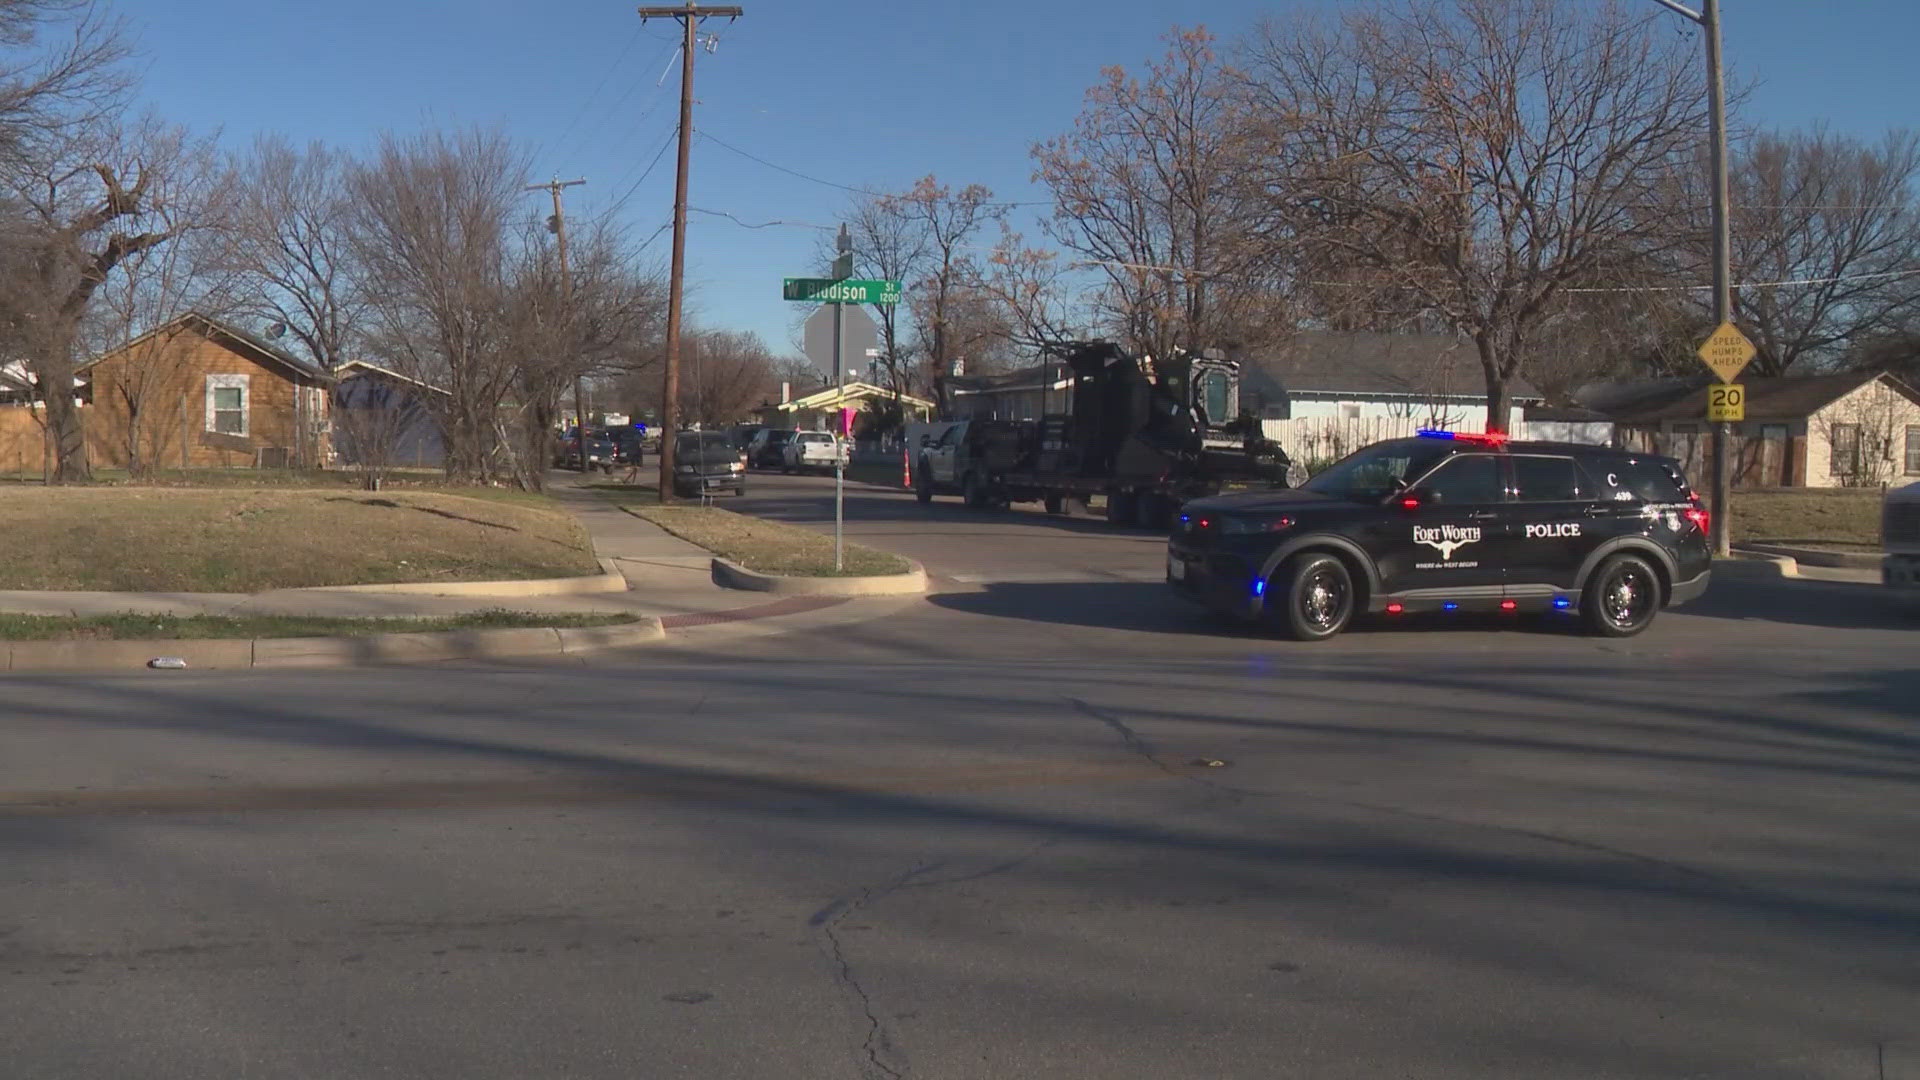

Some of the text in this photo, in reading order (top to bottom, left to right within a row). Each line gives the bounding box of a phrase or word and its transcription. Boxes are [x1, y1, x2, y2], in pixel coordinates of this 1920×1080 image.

[885, 283, 894, 292] St
[880, 293, 899, 302] 1200
[1713, 337, 1741, 346] SPEED
[1712, 347, 1742, 355] HUMPS
[1713, 358, 1742, 366] AHEAD
[1713, 389, 1740, 406] 20
[1716, 408, 1737, 416] MPH
[1607, 473, 1618, 487] C
[1413, 524, 1480, 541] FORT WORTH
[1525, 524, 1581, 537] POLICE
